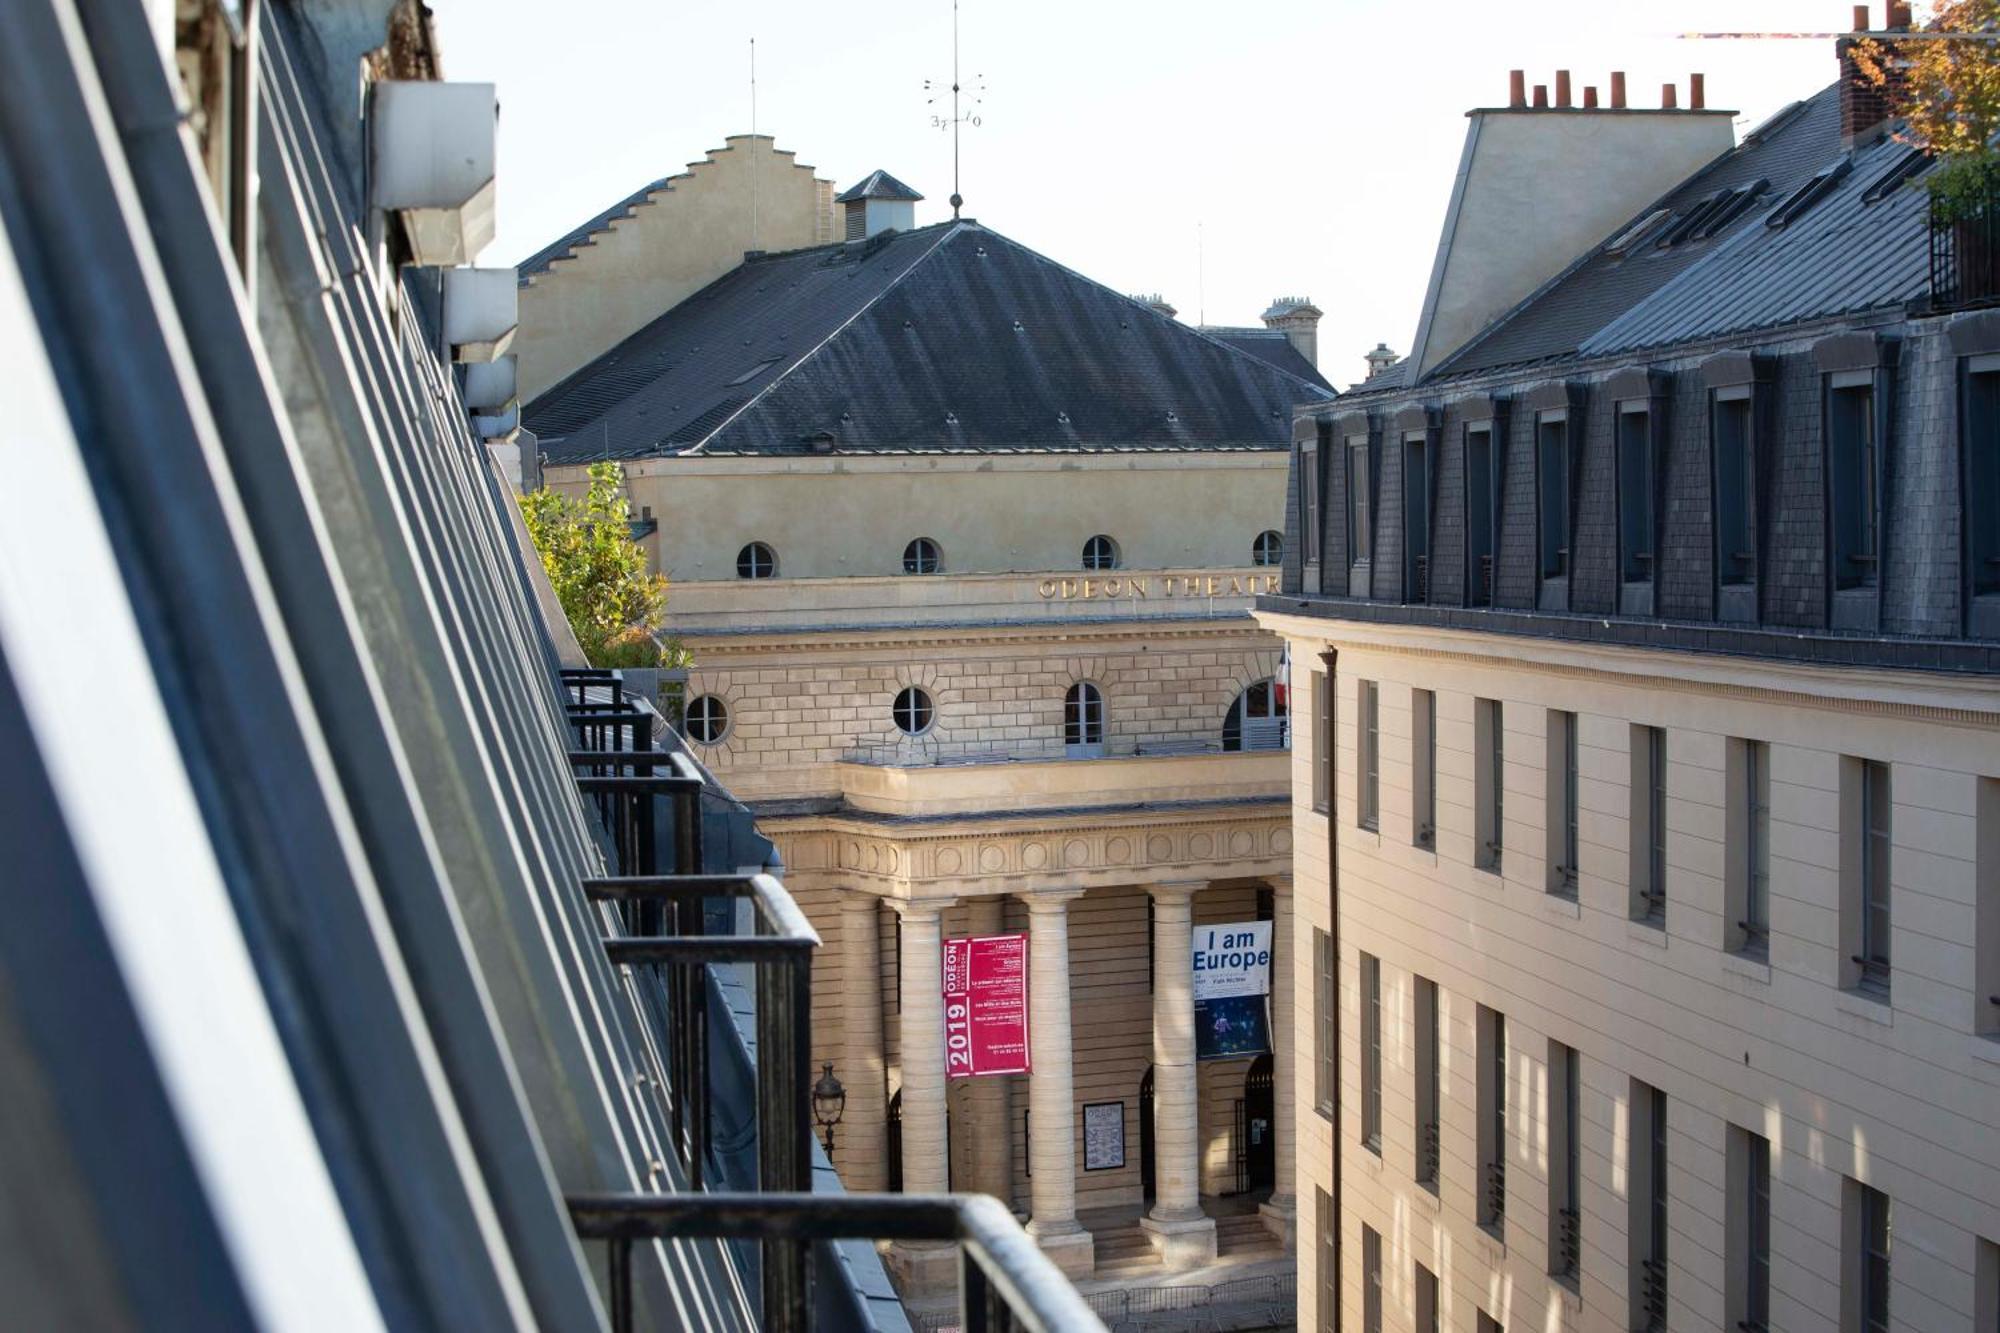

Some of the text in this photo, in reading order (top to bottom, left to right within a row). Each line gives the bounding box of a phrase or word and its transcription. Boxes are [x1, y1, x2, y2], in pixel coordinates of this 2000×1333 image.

[1039, 577, 1146, 599] ODEON
[1208, 931, 1254, 950] I am
[1193, 950, 1269, 971] Europe
[947, 1004, 969, 1066] 2019
